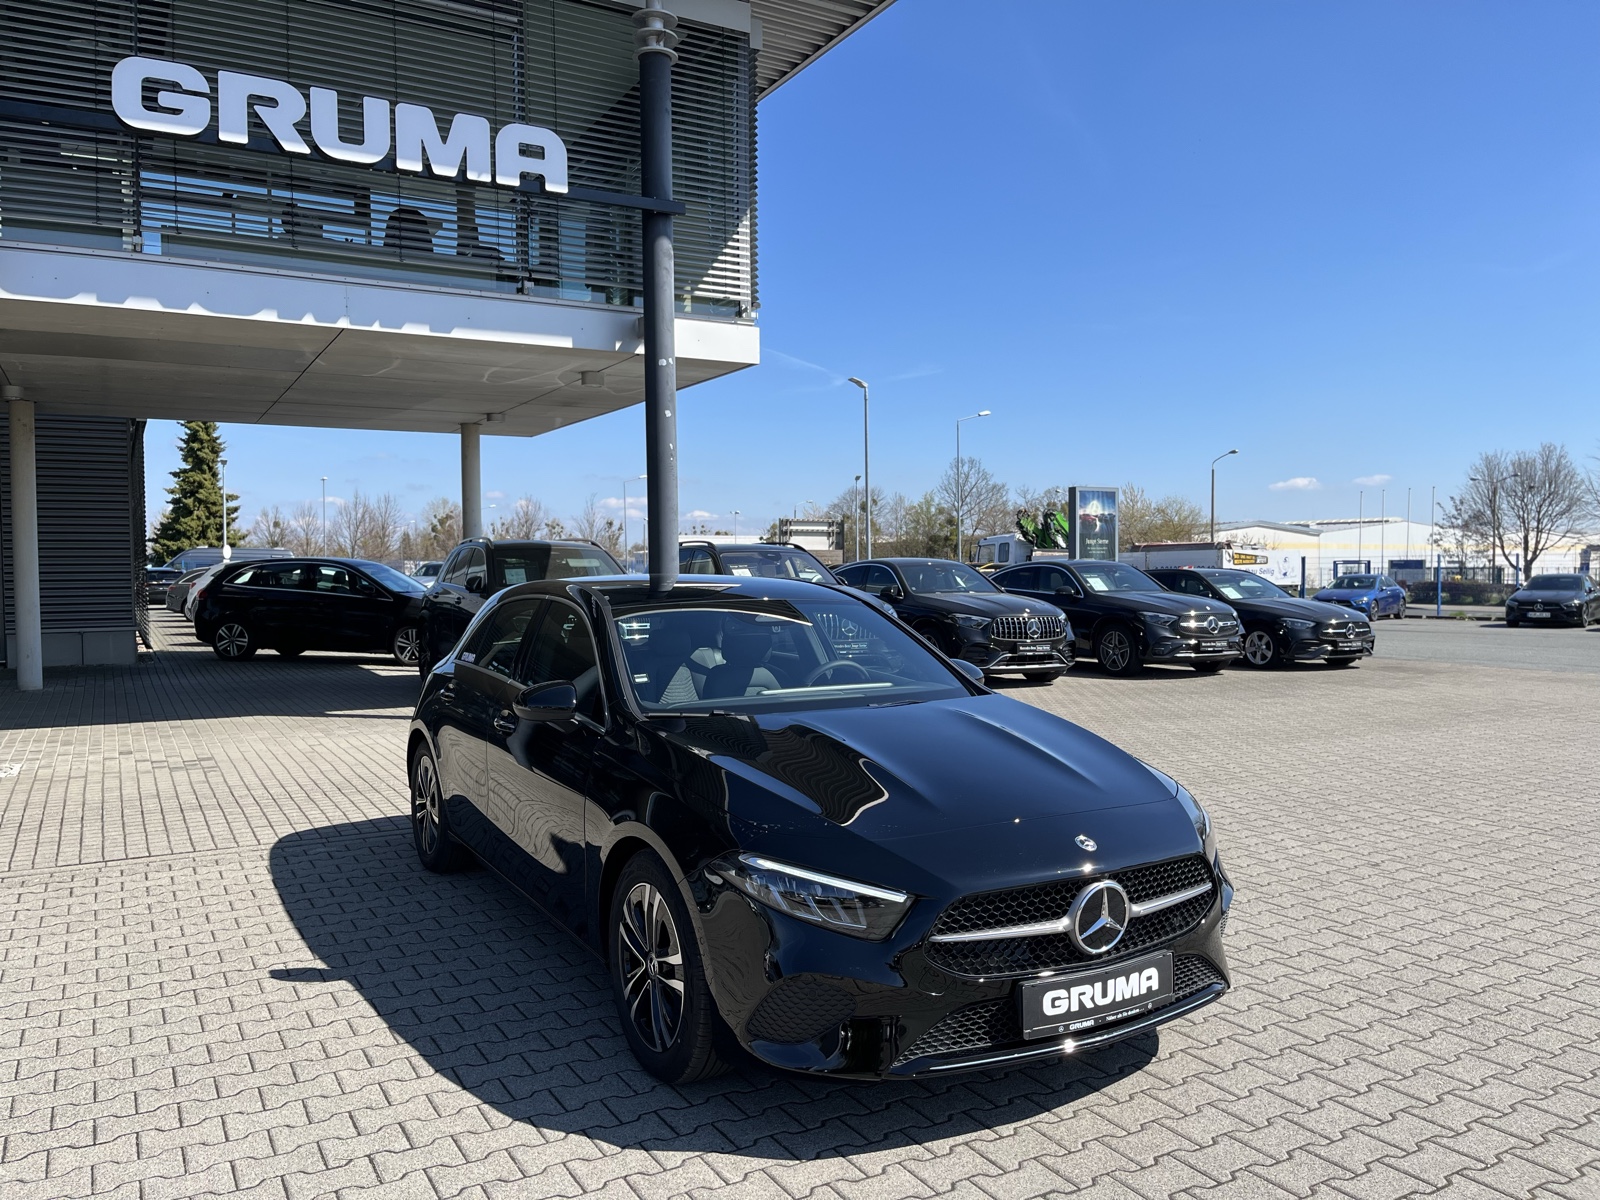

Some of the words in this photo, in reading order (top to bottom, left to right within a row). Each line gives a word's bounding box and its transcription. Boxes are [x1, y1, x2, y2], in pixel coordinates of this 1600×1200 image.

[111, 56, 568, 193] GRUMA
[1042, 967, 1159, 1016] GRUMA
[1069, 1019, 1095, 1030] GRUMA
